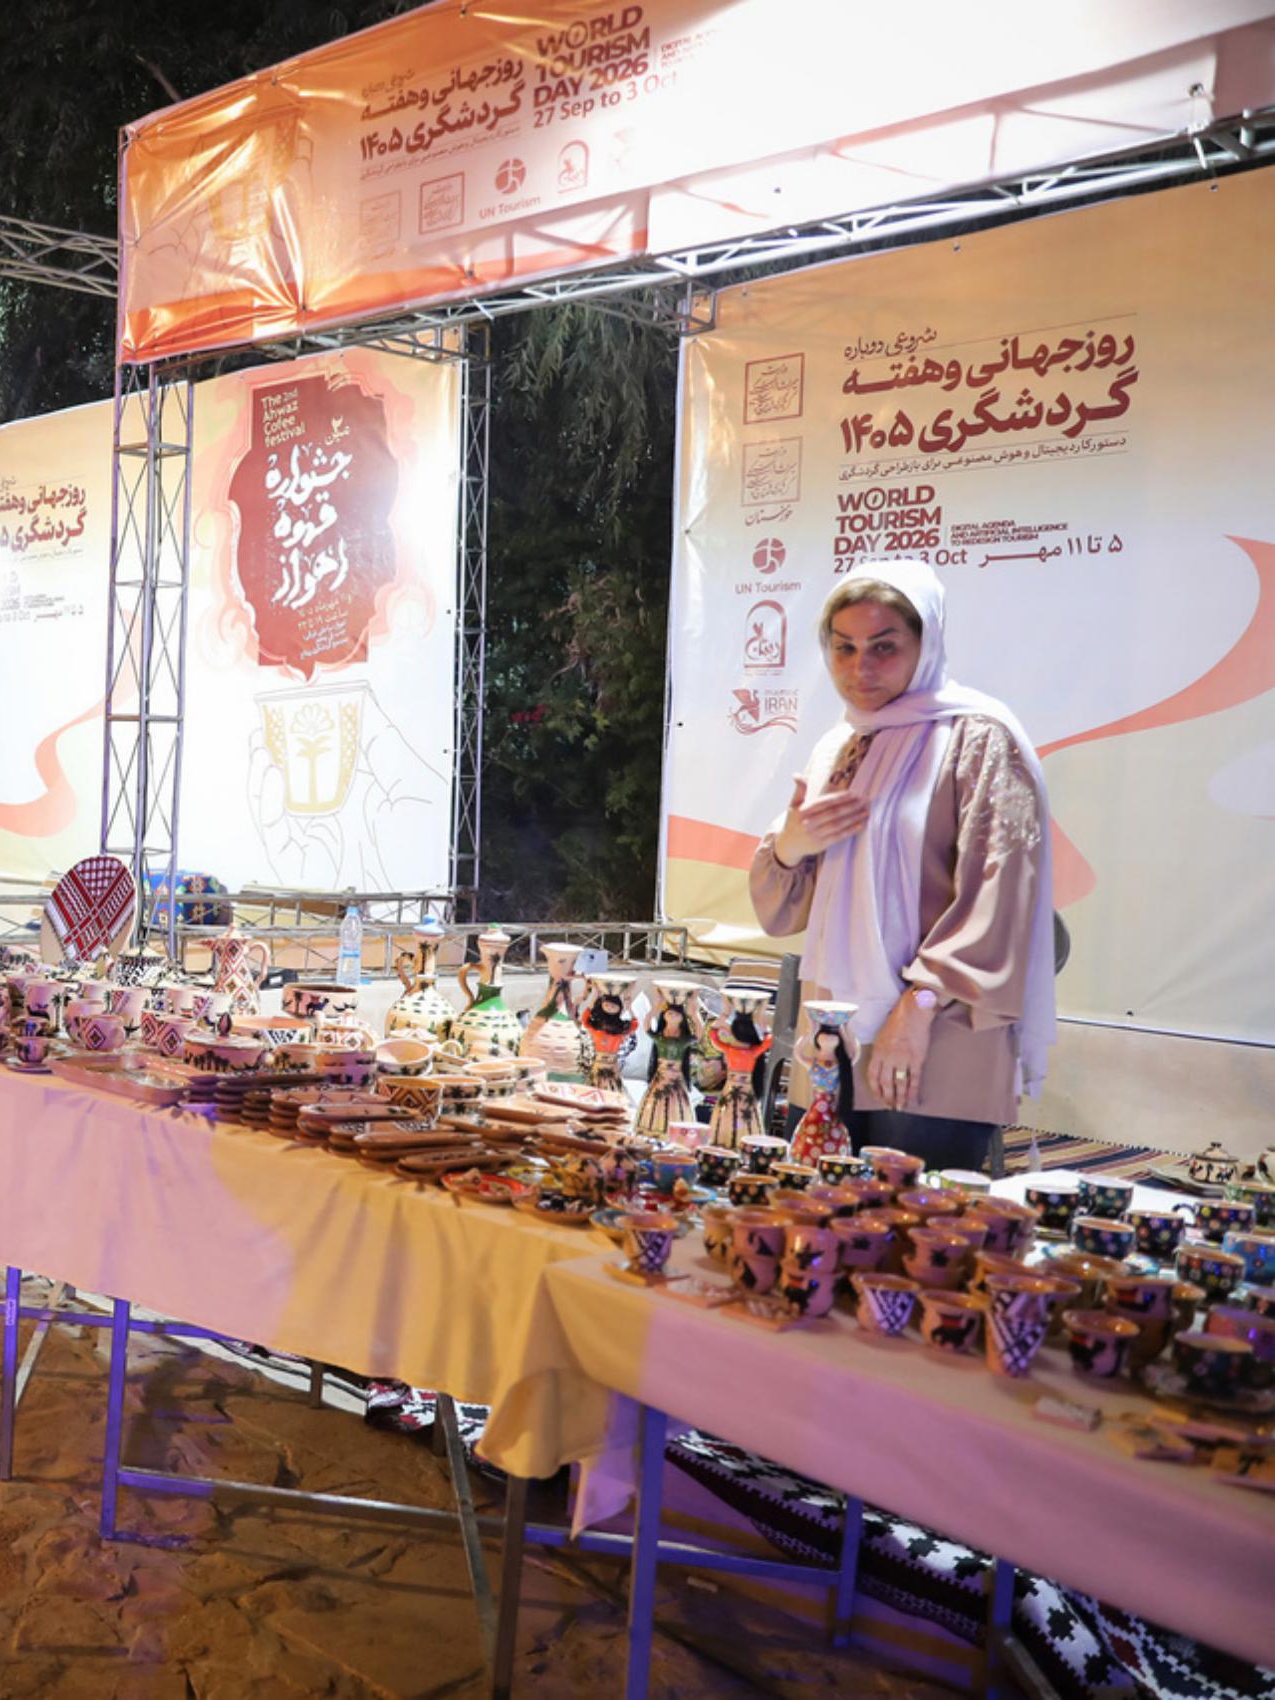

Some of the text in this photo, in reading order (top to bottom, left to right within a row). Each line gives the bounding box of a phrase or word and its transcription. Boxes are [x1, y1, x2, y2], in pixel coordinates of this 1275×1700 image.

[537, 5, 643, 57] WORLD
[535, 26, 651, 83] TOURISM
[533, 53, 649, 108] DAY 2026
[405, 79, 526, 154] گردشگری
[533, 107, 555, 128] 27
[560, 98, 595, 120] Sep
[601, 91, 621, 108] to
[626, 81, 638, 101] 3
[360, 126, 403, 161] ۱۴۰۵
[479, 196, 541, 219] UN Tourism
[261, 394, 282, 408] The
[840, 365, 1139, 453] گردشگری ۱۴۰۵
[837, 485, 936, 513] WORLD
[836, 506, 942, 534] TOURISM
[834, 528, 941, 555] DAY 2026
[978, 534, 1123, 568] ۵ تا ۱۱ مهر
[834, 557, 855, 574] 27
[935, 549, 968, 566] Oct
[735, 580, 802, 595] UN Tourism
[765, 697, 798, 712] IRAN
